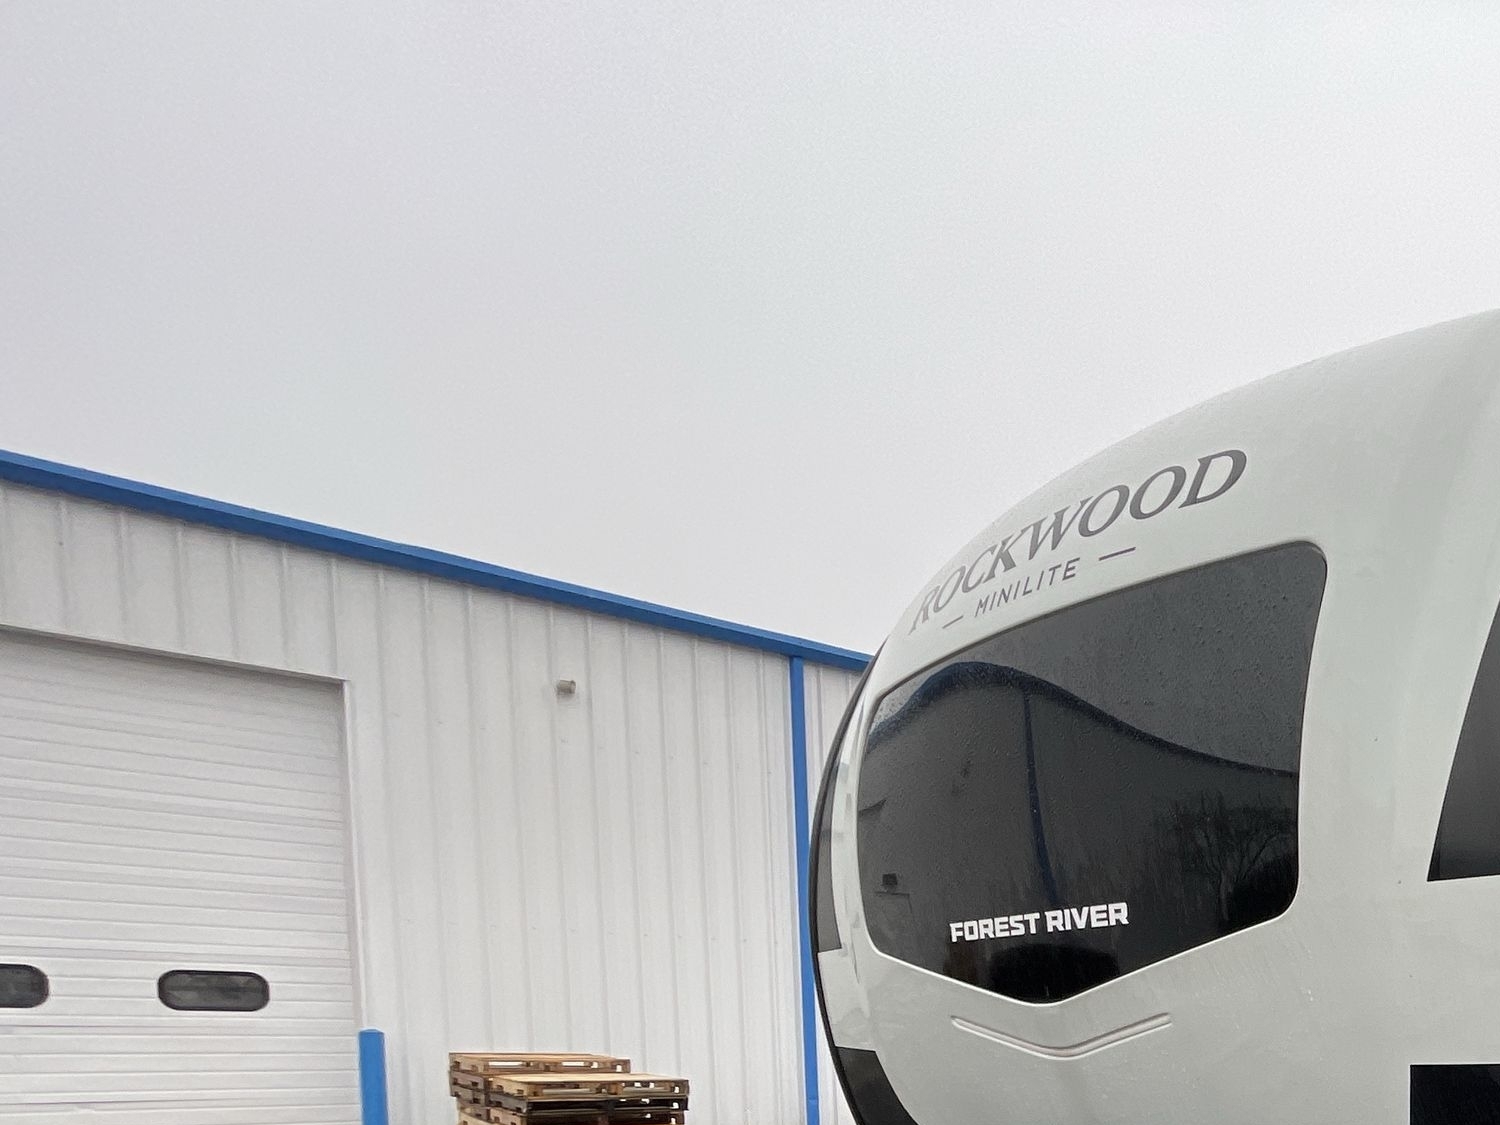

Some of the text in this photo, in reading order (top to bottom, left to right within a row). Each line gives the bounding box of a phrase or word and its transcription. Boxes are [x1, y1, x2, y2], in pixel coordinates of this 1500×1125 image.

[909, 449, 1247, 635] ROCKWOOD
[974, 557, 1080, 617] MINILITE
[950, 902, 1129, 942] FOREST RIVER
